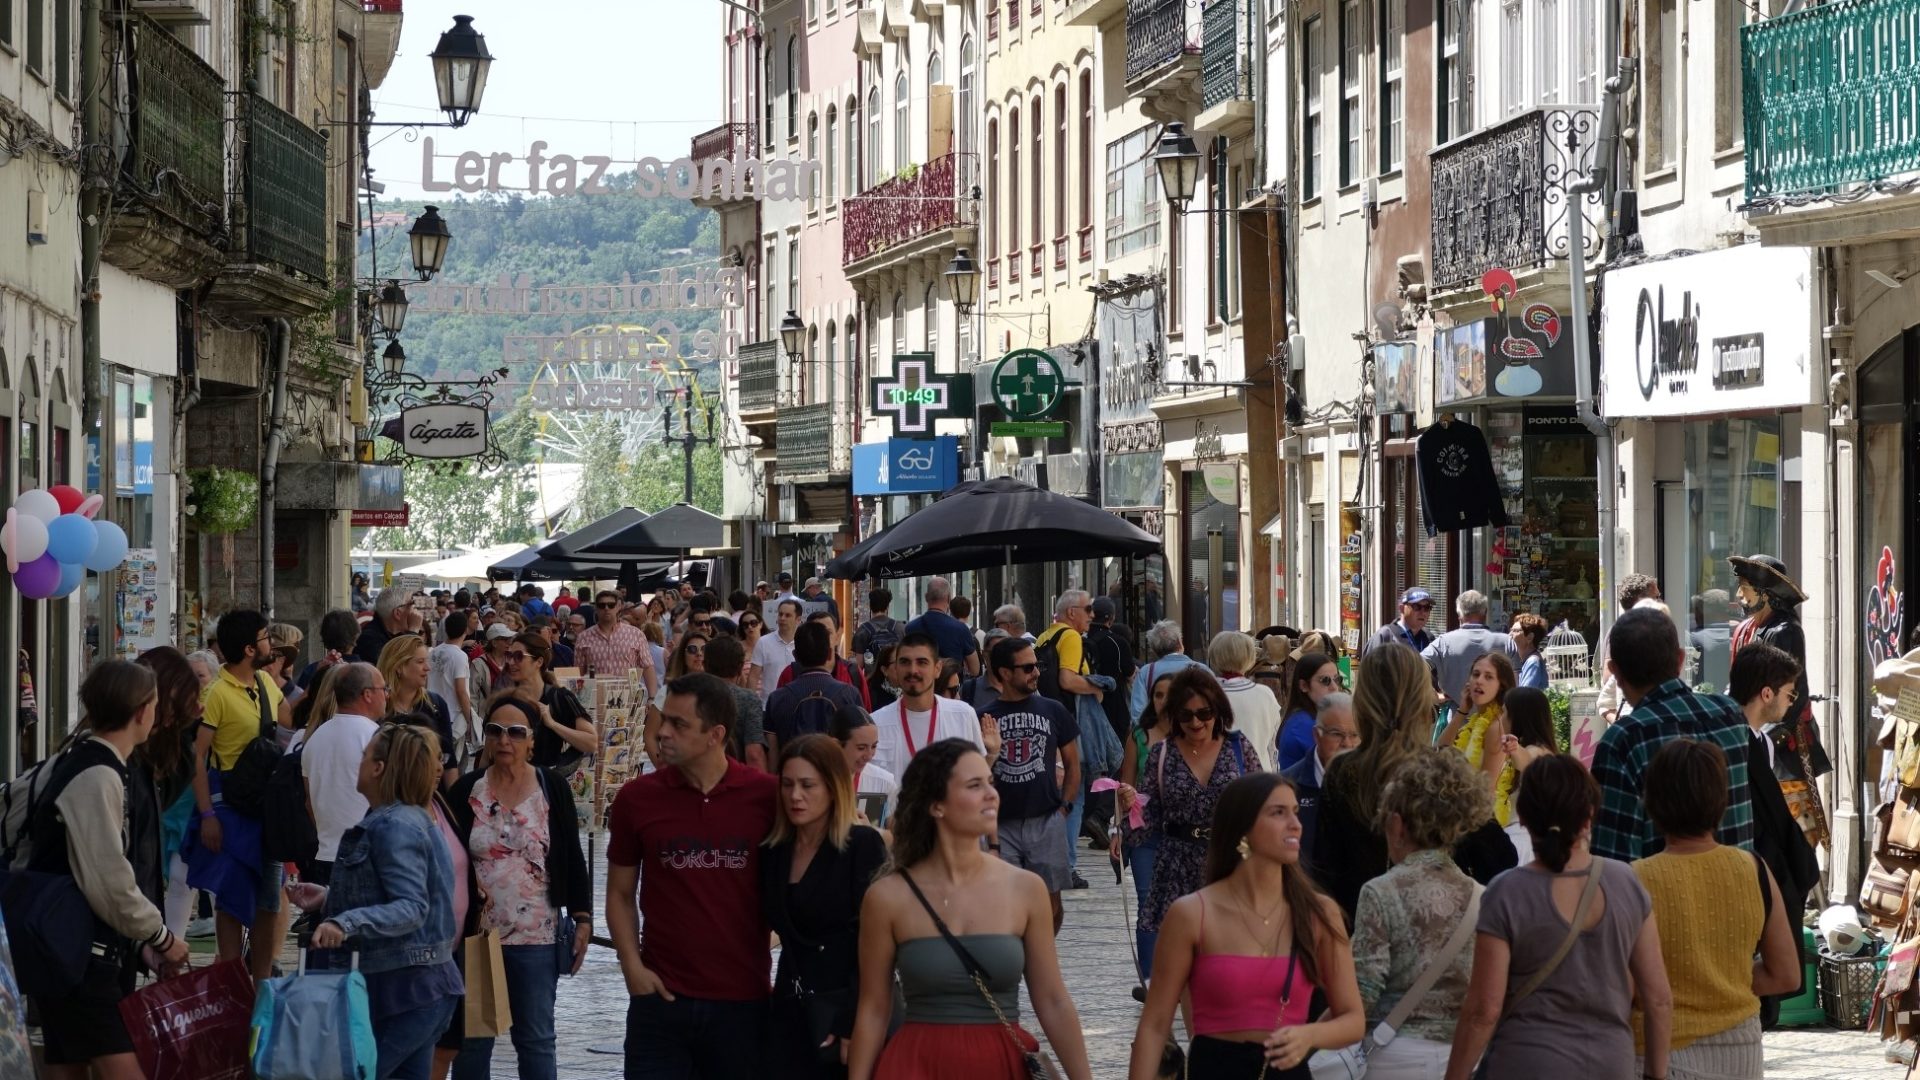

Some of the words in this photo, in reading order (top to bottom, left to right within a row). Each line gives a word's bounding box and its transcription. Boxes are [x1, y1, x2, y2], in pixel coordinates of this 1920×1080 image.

[422, 136, 512, 193] Ler
[526, 140, 611, 196] faz
[635, 144, 823, 201] sonhar
[889, 388, 935, 405] 10:49
[659, 849, 748, 869] PORCHES
